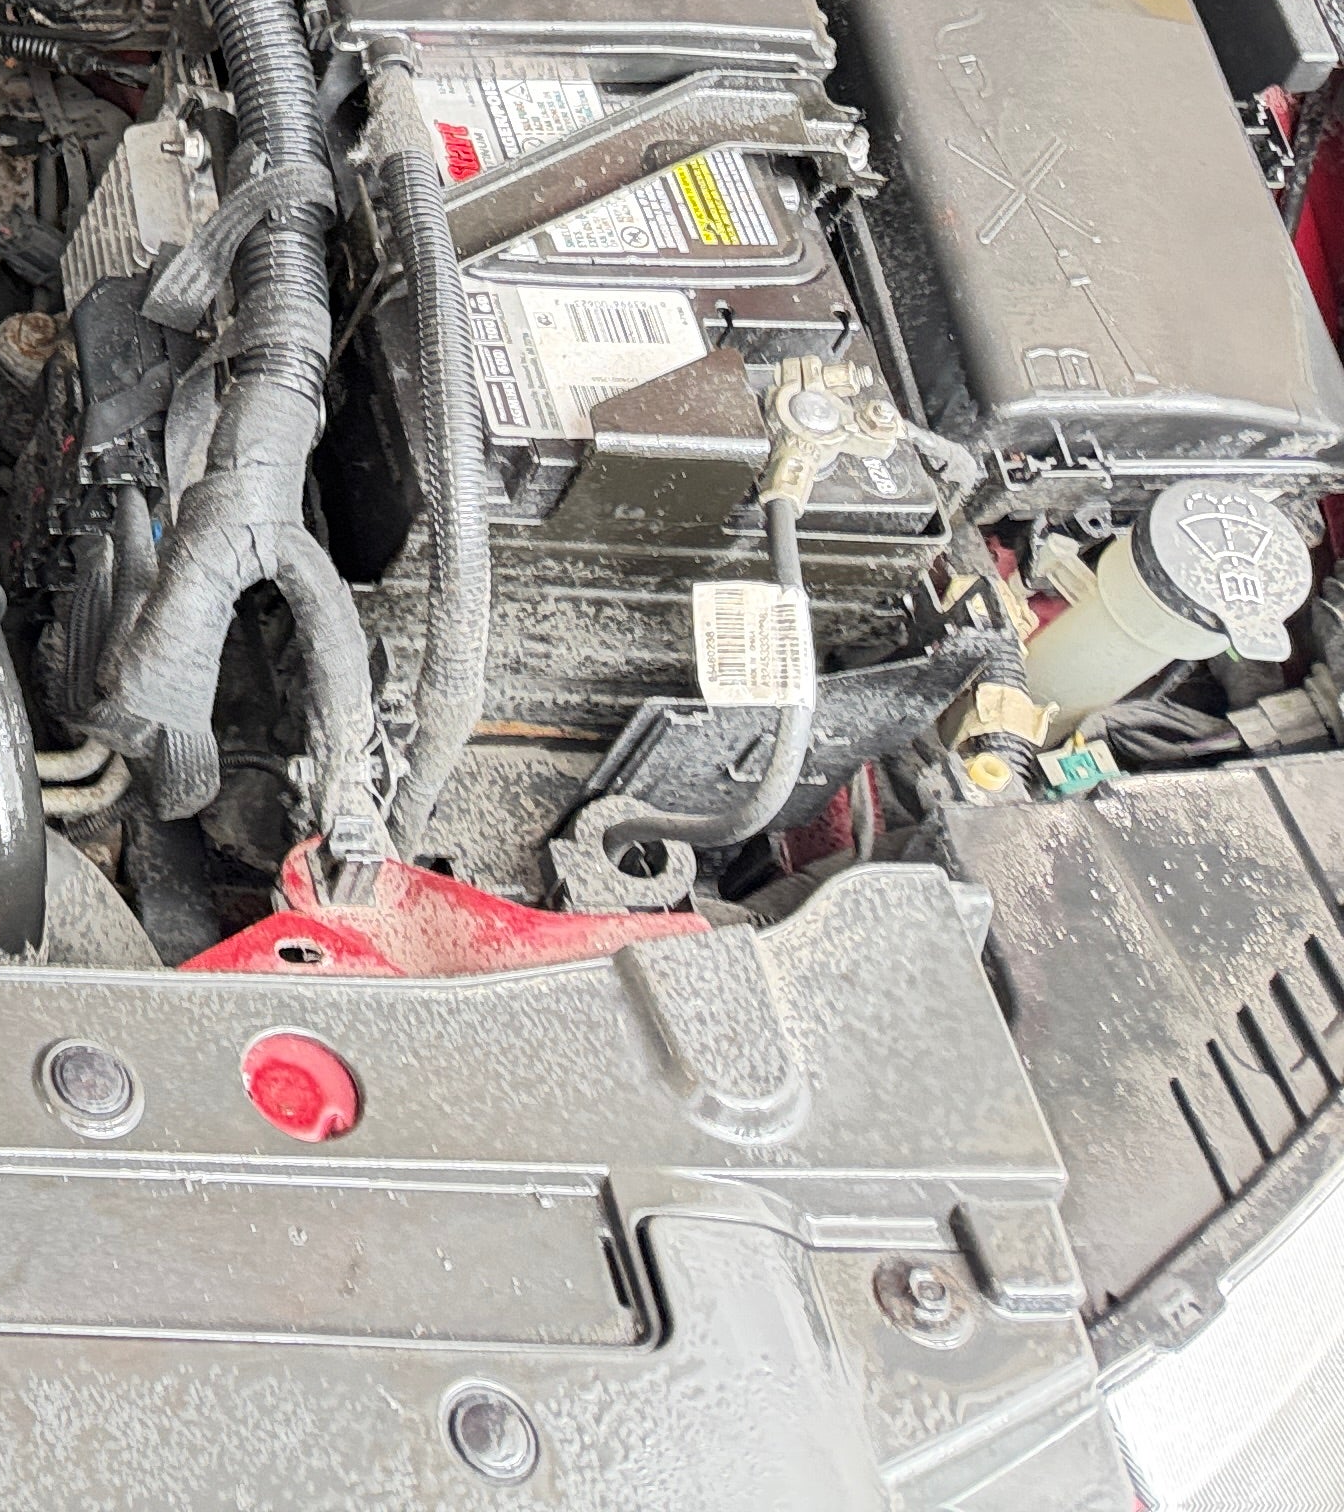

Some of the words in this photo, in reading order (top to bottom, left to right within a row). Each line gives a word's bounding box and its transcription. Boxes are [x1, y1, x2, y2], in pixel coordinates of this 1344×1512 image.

[481, 80, 516, 158] NGER/POIS
[436, 122, 480, 182] Start
[474, 132, 495, 168] TINUM
